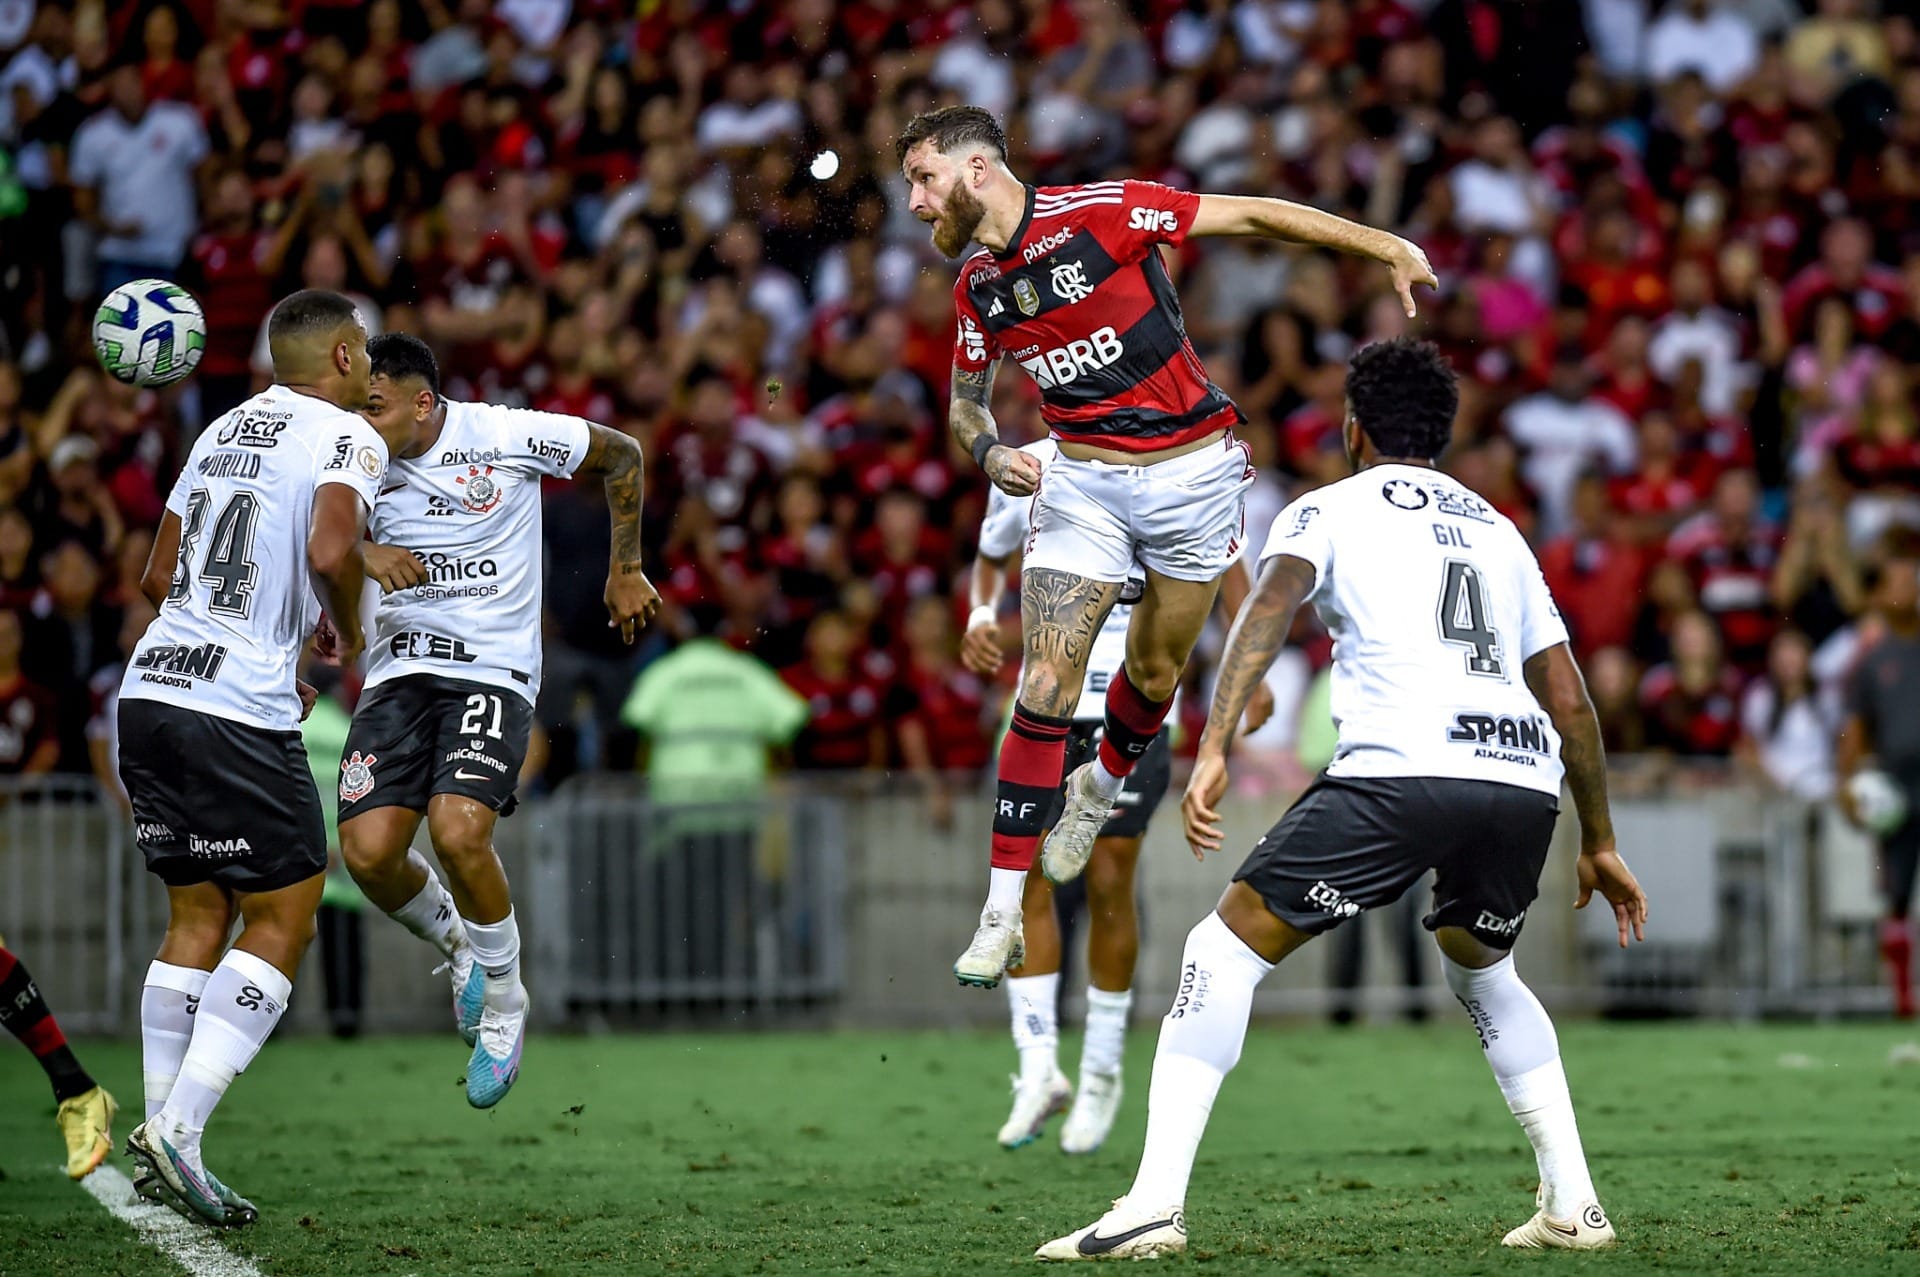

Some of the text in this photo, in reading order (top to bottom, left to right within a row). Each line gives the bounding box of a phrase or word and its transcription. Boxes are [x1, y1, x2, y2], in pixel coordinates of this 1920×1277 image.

[1023, 226, 1074, 265] pixbet
[1048, 326, 1124, 386] BRB
[241, 417, 287, 437] SCCP
[441, 447, 502, 465] pixbet
[539, 440, 571, 467] bmg
[424, 508, 456, 517] ALE
[1432, 523, 1473, 549] GIL
[167, 487, 259, 621] 34
[412, 551, 448, 567] eo
[426, 558, 498, 583] mica
[414, 585, 499, 600] Genéricos
[1436, 556, 1508, 682] 4
[140, 672, 193, 691] ATACADISTA
[459, 693, 503, 740] 21
[995, 797, 1037, 819] RF
[1171, 960, 1196, 1019] TODOS
[265, 1001, 277, 1014] de
